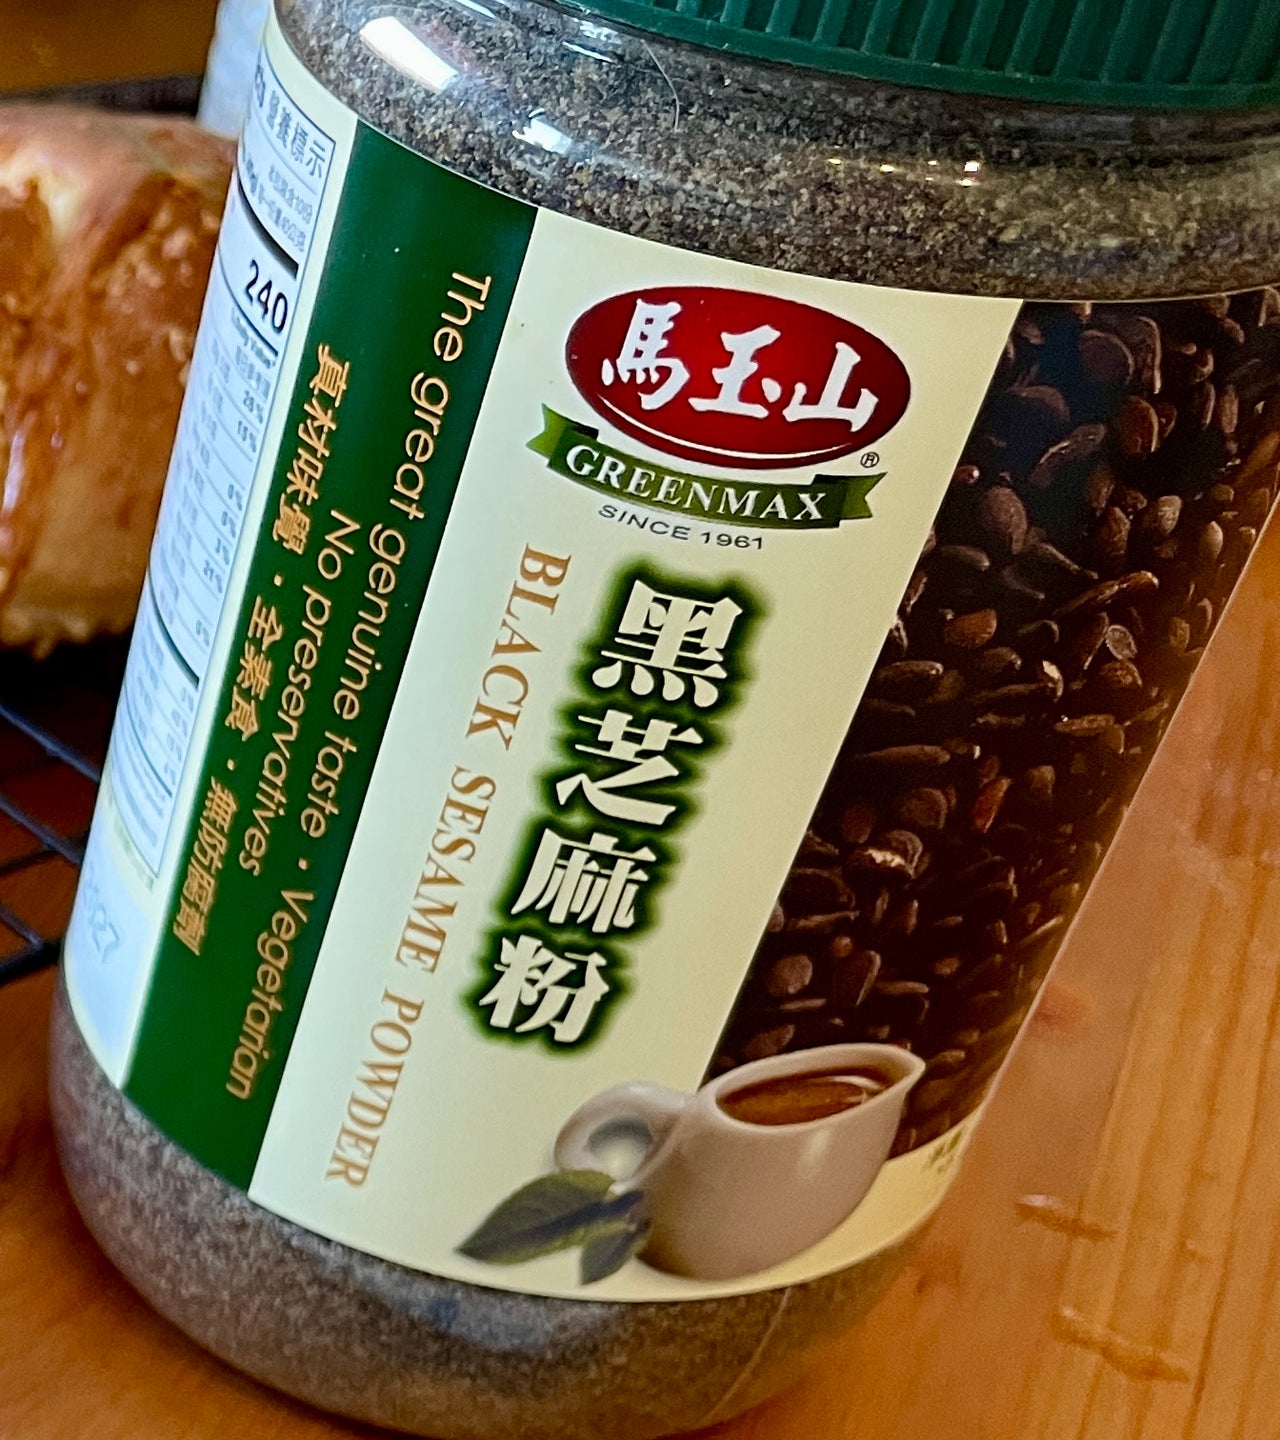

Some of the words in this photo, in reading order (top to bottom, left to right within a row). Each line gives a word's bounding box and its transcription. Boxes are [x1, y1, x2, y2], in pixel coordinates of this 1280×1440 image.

[244, 259, 288, 334] 240
[433, 271, 492, 362] The
[601, 298, 880, 433] 馬玉山
[390, 371, 450, 520] great
[565, 443, 826, 520] GREENMAX
[316, 509, 361, 580] No
[598, 503, 691, 541] SINCE
[700, 530, 764, 550] 1961
[225, 594, 284, 742] 全素食
[333, 522, 406, 721] genuine
[465, 543, 572, 752] BLACK
[238, 583, 332, 876] preservatives
[300, 730, 358, 838] taste
[395, 764, 497, 976] SESAME
[479, 579, 743, 1043] 黑芝麻粉
[226, 888, 316, 1100] Vegetarian
[324, 987, 425, 1189] POWDER
